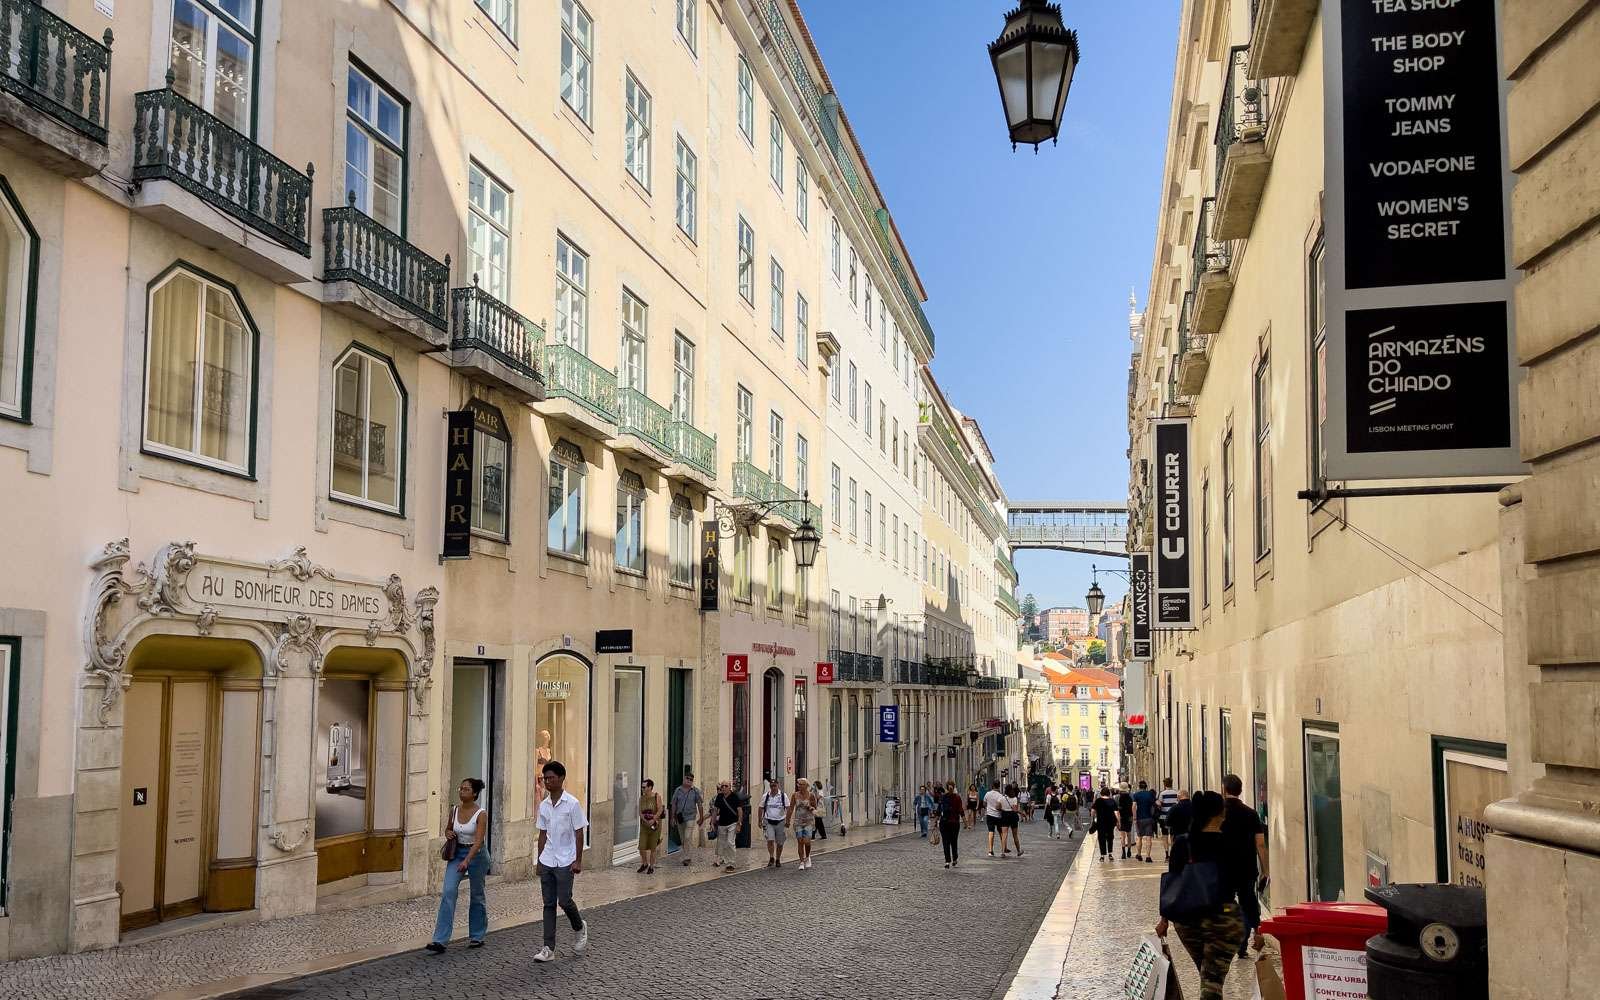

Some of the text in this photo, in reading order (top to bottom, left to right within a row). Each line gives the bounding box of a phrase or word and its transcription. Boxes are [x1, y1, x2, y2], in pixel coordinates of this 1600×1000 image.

[1372, 0, 1408, 13] TEA
[1372, 31, 1466, 51] THE BODY
[1393, 56, 1446, 73] SHOP
[1385, 94, 1456, 113] TOMMY
[1391, 118, 1451, 136] JEANS
[1369, 156, 1476, 177] VODAFONE
[1377, 197, 1469, 216] WOMEN'S
[1387, 221, 1460, 239] SECRET
[1368, 335, 1485, 358] ARMAZÉNS
[1368, 359, 1401, 376] DO
[1368, 374, 1451, 393] CHIADO
[1368, 423, 1454, 433] LISBON MEETING POINT
[450, 427, 471, 524] HAIR
[1165, 452, 1180, 531] COURIR
[704, 531, 717, 590] HAIR
[202, 575, 380, 614] AU BONHEUR DES DAMES
[1136, 569, 1147, 625] MANGO
[1457, 815, 1494, 843] A HUSSE
[1458, 842, 1473, 865] traz
[1309, 972, 1343, 982] LIMPEZA
